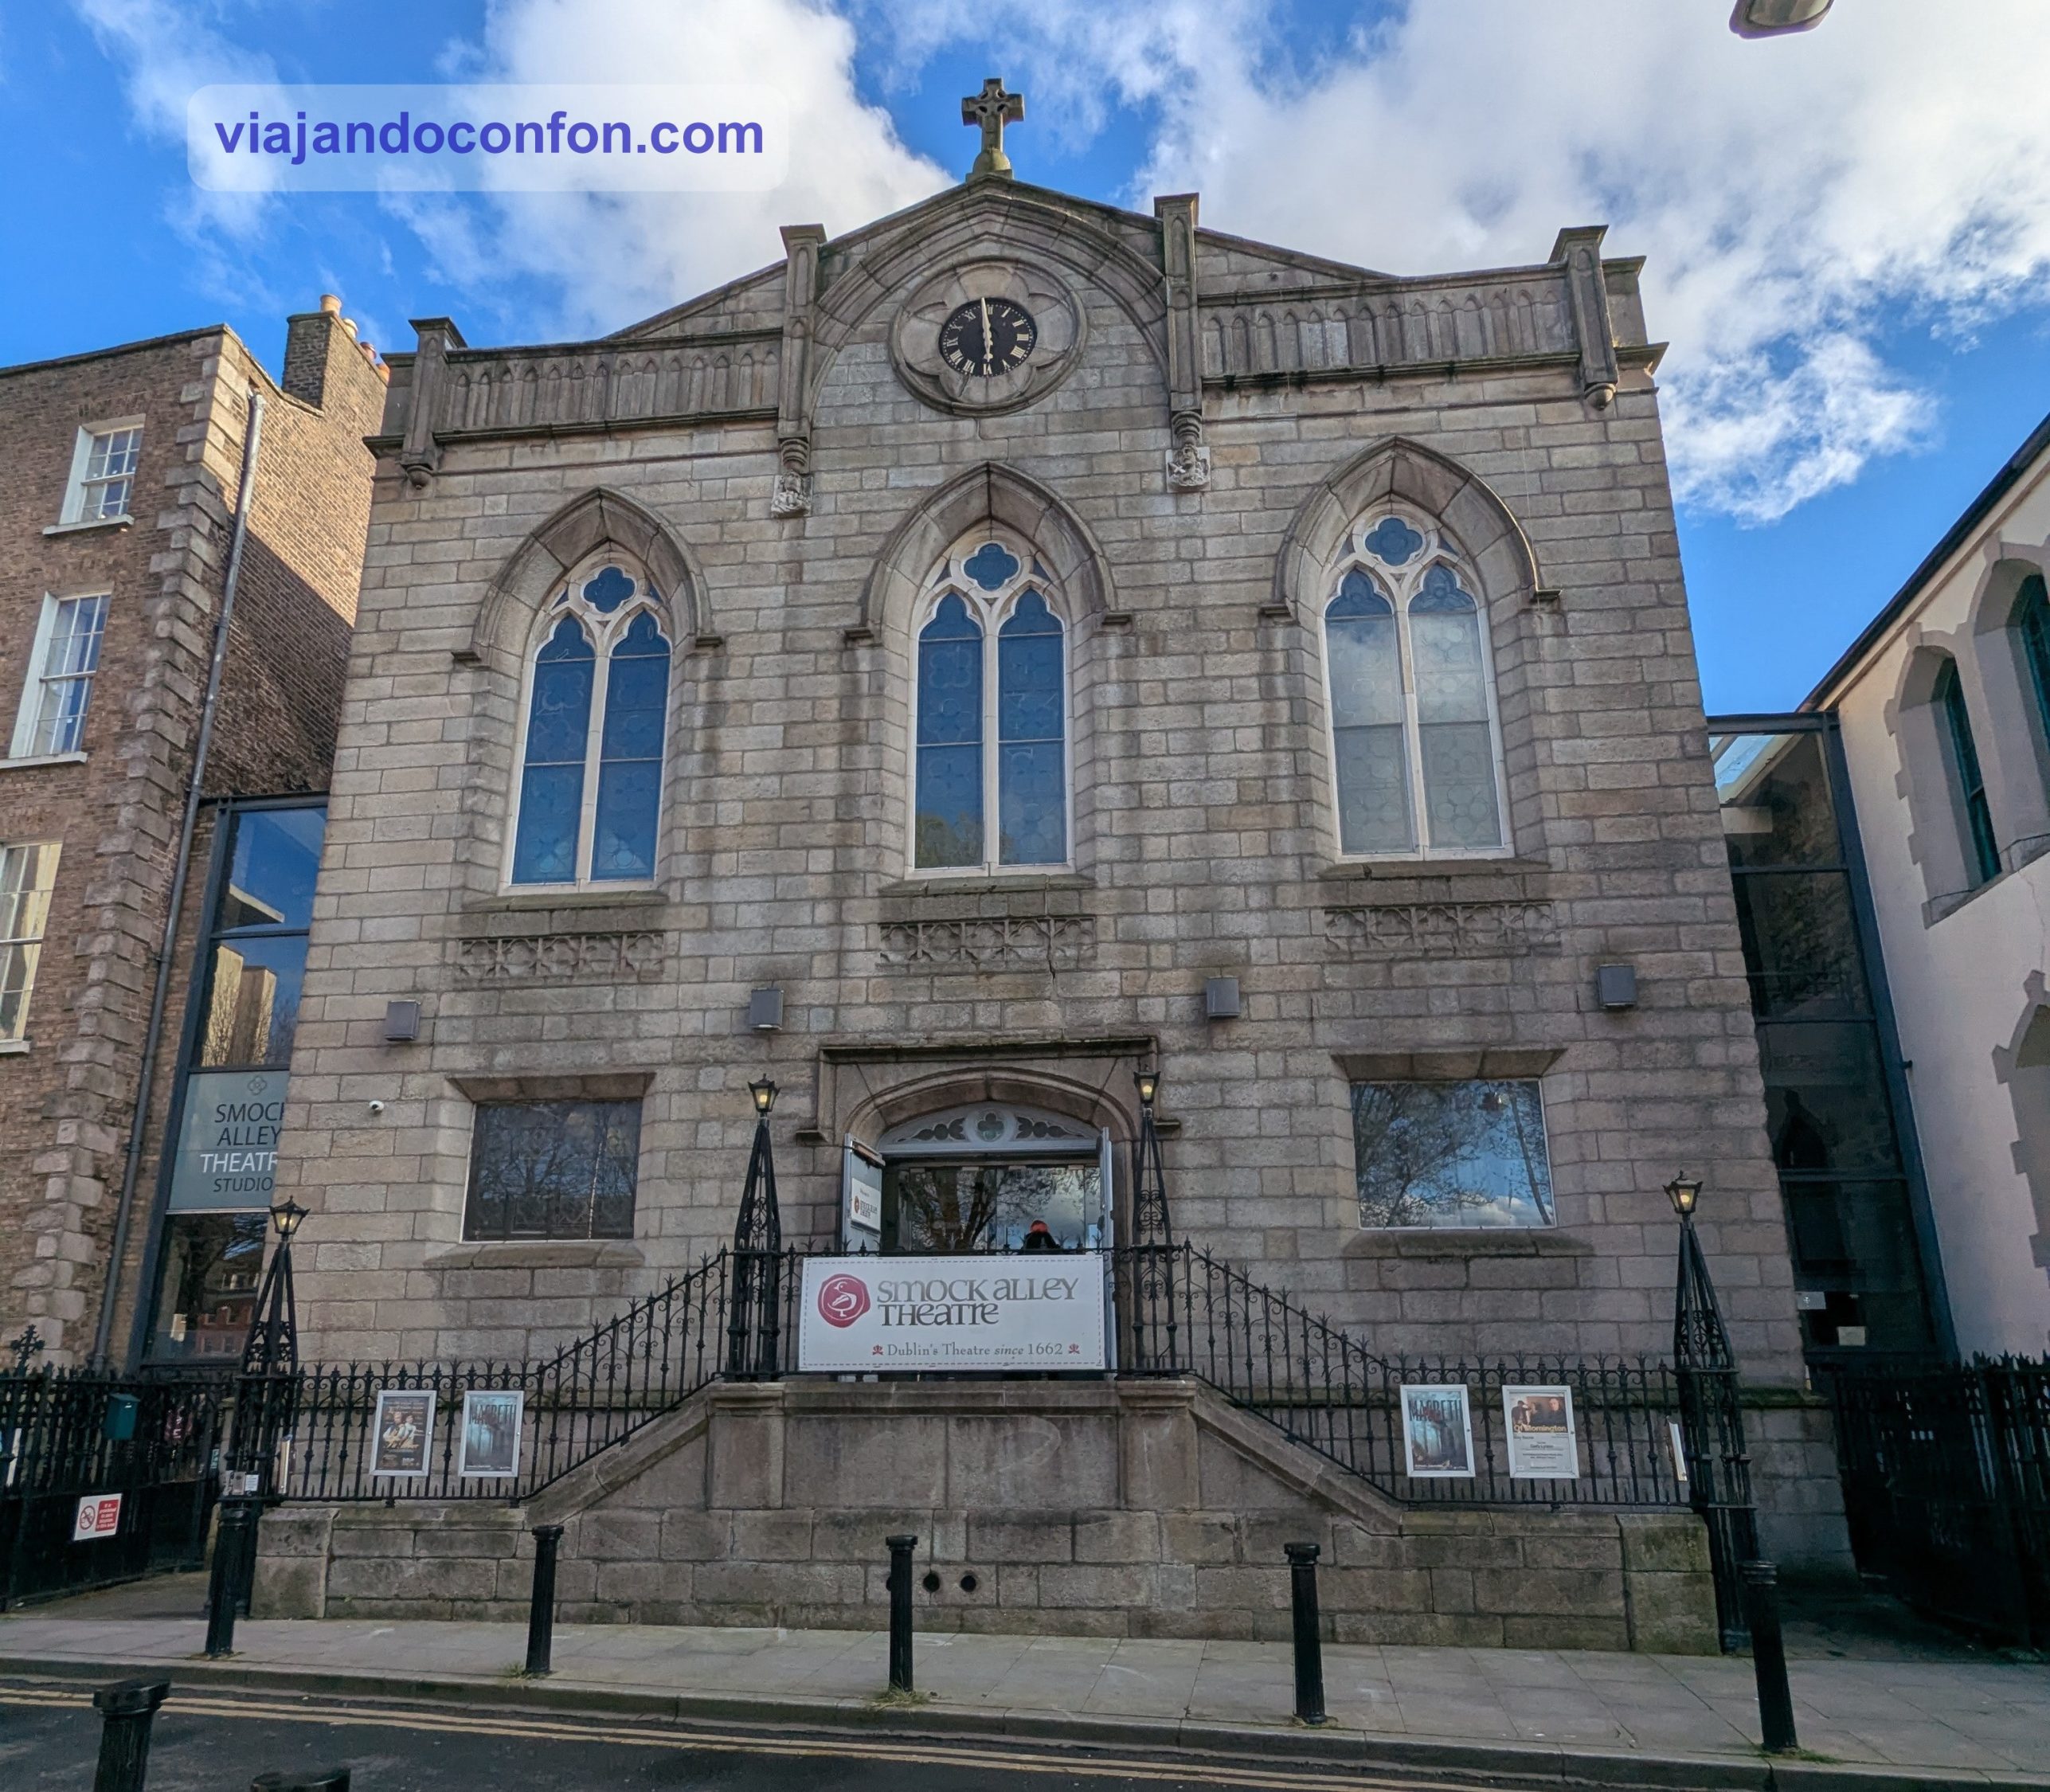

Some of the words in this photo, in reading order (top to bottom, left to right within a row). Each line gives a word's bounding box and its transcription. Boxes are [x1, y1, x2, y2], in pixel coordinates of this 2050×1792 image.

[887, 1342, 938, 1356] Dublin's
[942, 1342, 990, 1356] Theatre
[995, 1343, 1023, 1356] since
[1028, 1343, 1062, 1355] 1662
